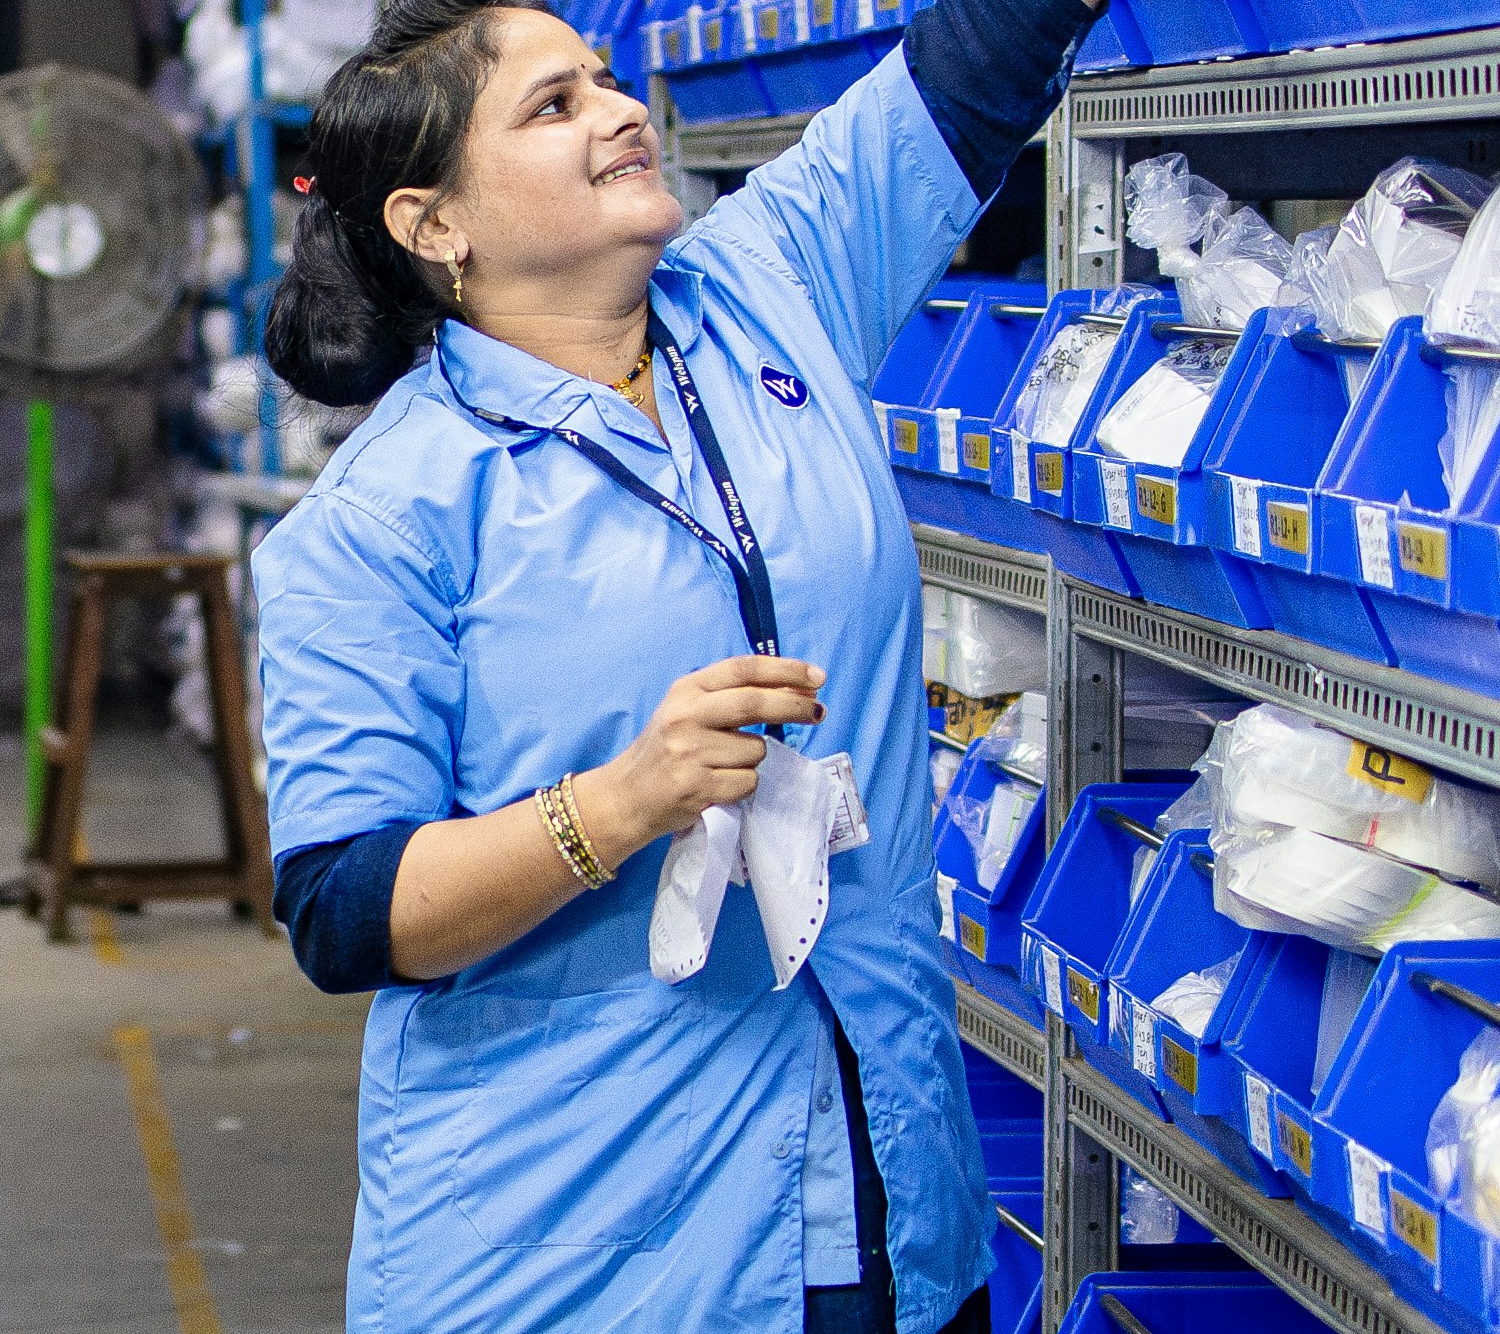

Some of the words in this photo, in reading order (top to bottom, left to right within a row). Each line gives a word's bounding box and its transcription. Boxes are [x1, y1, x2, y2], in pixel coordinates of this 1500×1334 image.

[665, 345, 690, 386] Welspun
[660, 500, 705, 538] Welspun
[721, 481, 746, 528] Welspun
[1362, 744, 1406, 784] P
